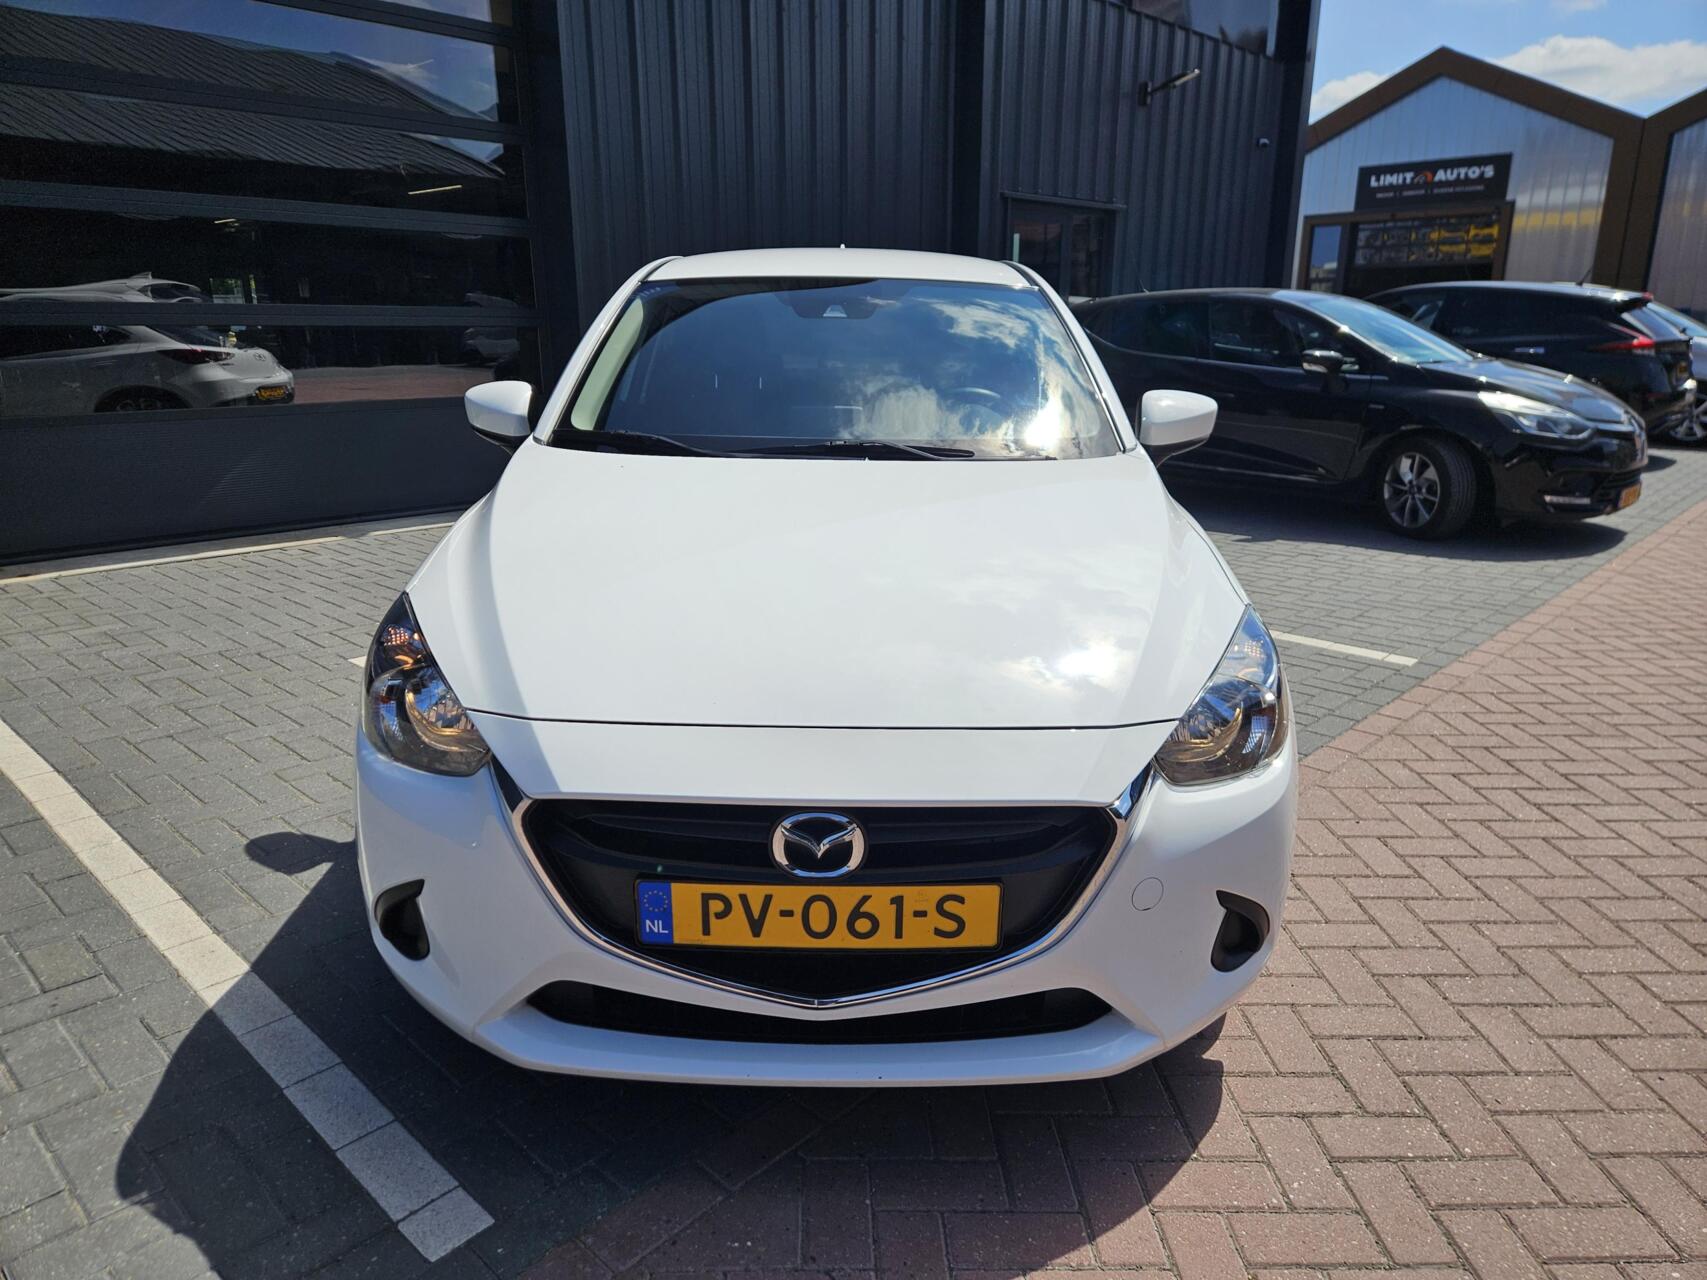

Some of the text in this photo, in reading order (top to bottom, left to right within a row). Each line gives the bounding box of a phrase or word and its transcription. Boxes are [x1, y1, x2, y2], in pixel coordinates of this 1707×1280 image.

[1370, 165, 1494, 187] LIMIT AUTO'S
[645, 919, 669, 934] NL
[700, 892, 966, 940] PV-061-S
